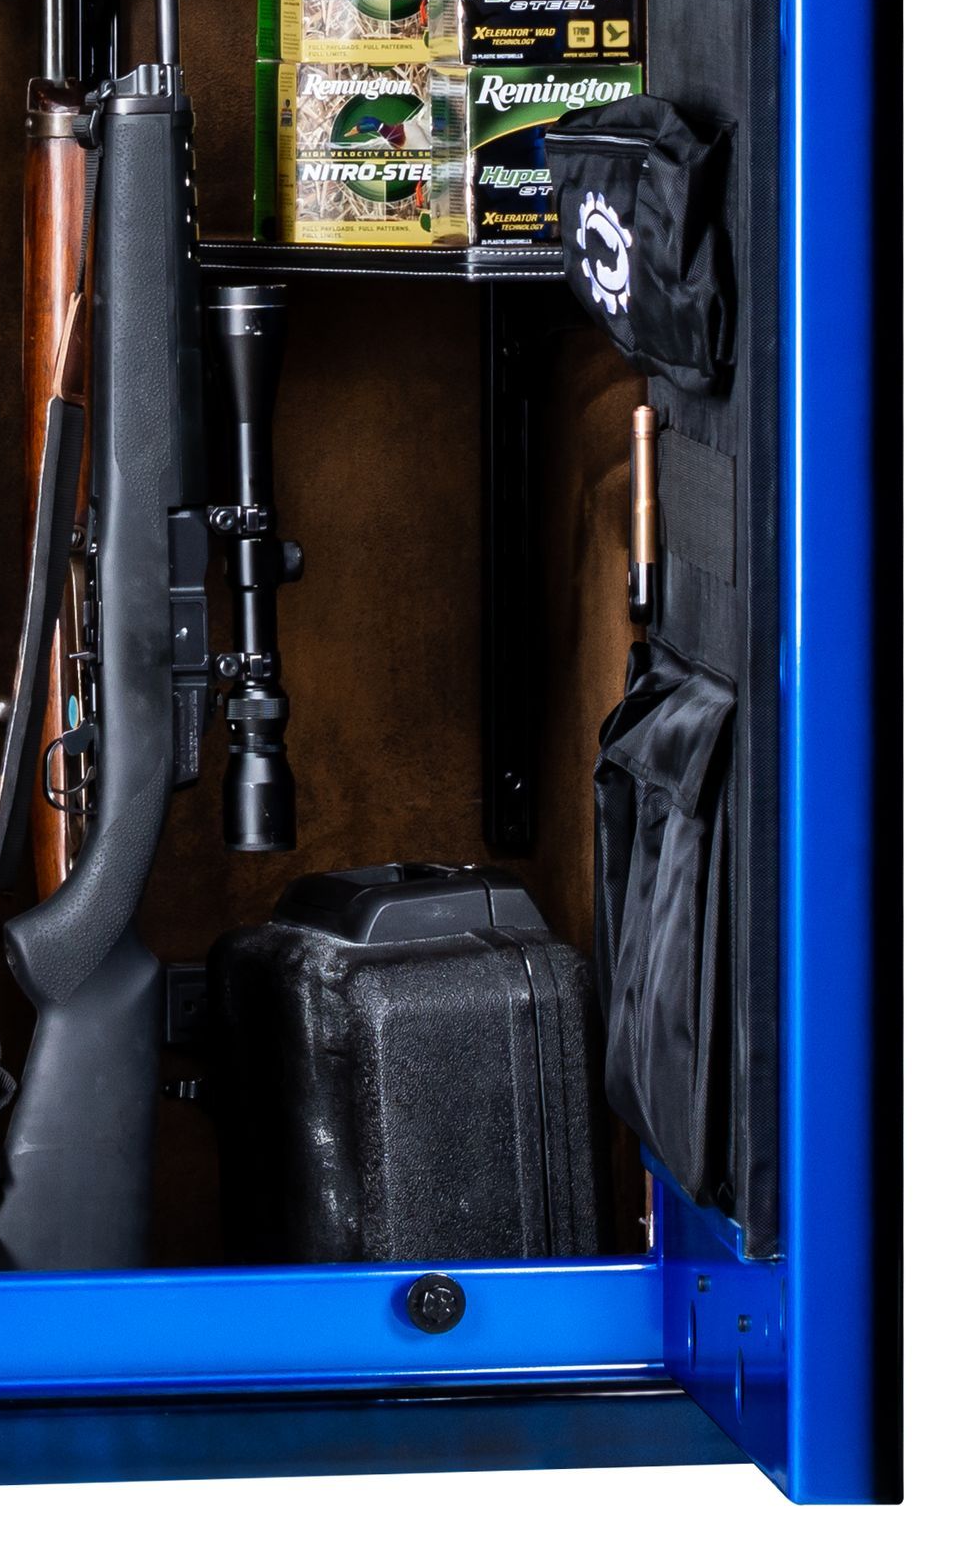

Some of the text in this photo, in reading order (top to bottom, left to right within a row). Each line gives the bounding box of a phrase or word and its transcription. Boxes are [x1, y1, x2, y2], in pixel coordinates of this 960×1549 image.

[510, 0, 595, 11] STEEL
[535, 28, 556, 37] WAD
[492, 38, 536, 46] TECHNOLOGY
[302, 74, 413, 100] Remington
[475, 75, 633, 111] Remington
[302, 164, 431, 181] NITRO-STEE
[544, 214, 558, 222] WA
